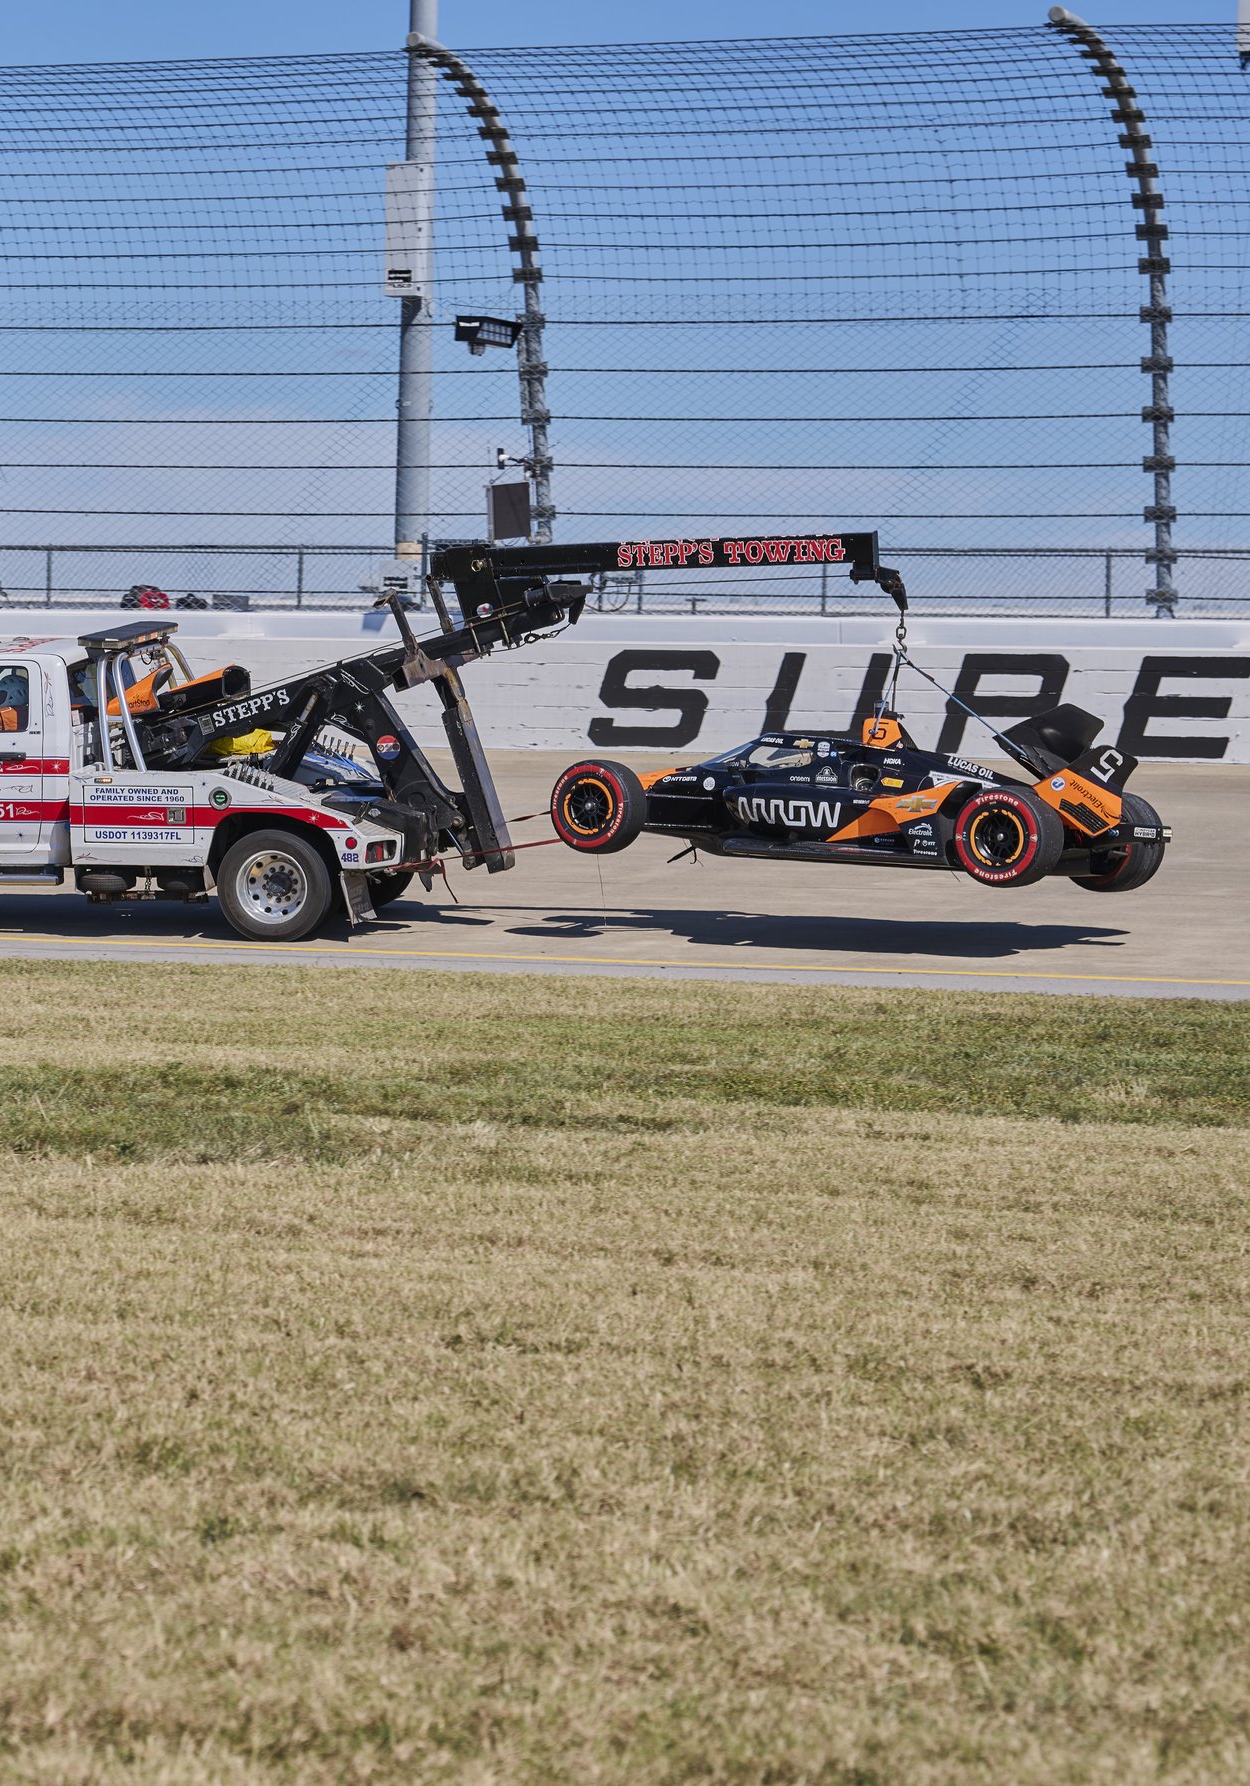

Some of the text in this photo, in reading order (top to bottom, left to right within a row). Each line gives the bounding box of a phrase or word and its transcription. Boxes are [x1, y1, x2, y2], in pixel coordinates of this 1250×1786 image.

[617, 542, 714, 568] STEPP'S
[723, 539, 846, 564] TOWING
[212, 688, 290, 728] STEPP'S
[947, 756, 994, 780] LUCAS OIL
[1090, 749, 1124, 783] 5
[95, 787, 126, 795] FAMILY
[90, 795, 135, 803] OPERATED
[975, 793, 1019, 807] Firestone
[95, 830, 182, 841] USDOT 1139317FL
[341, 852, 360, 863] 482
[974, 869, 1018, 881] Firestone
